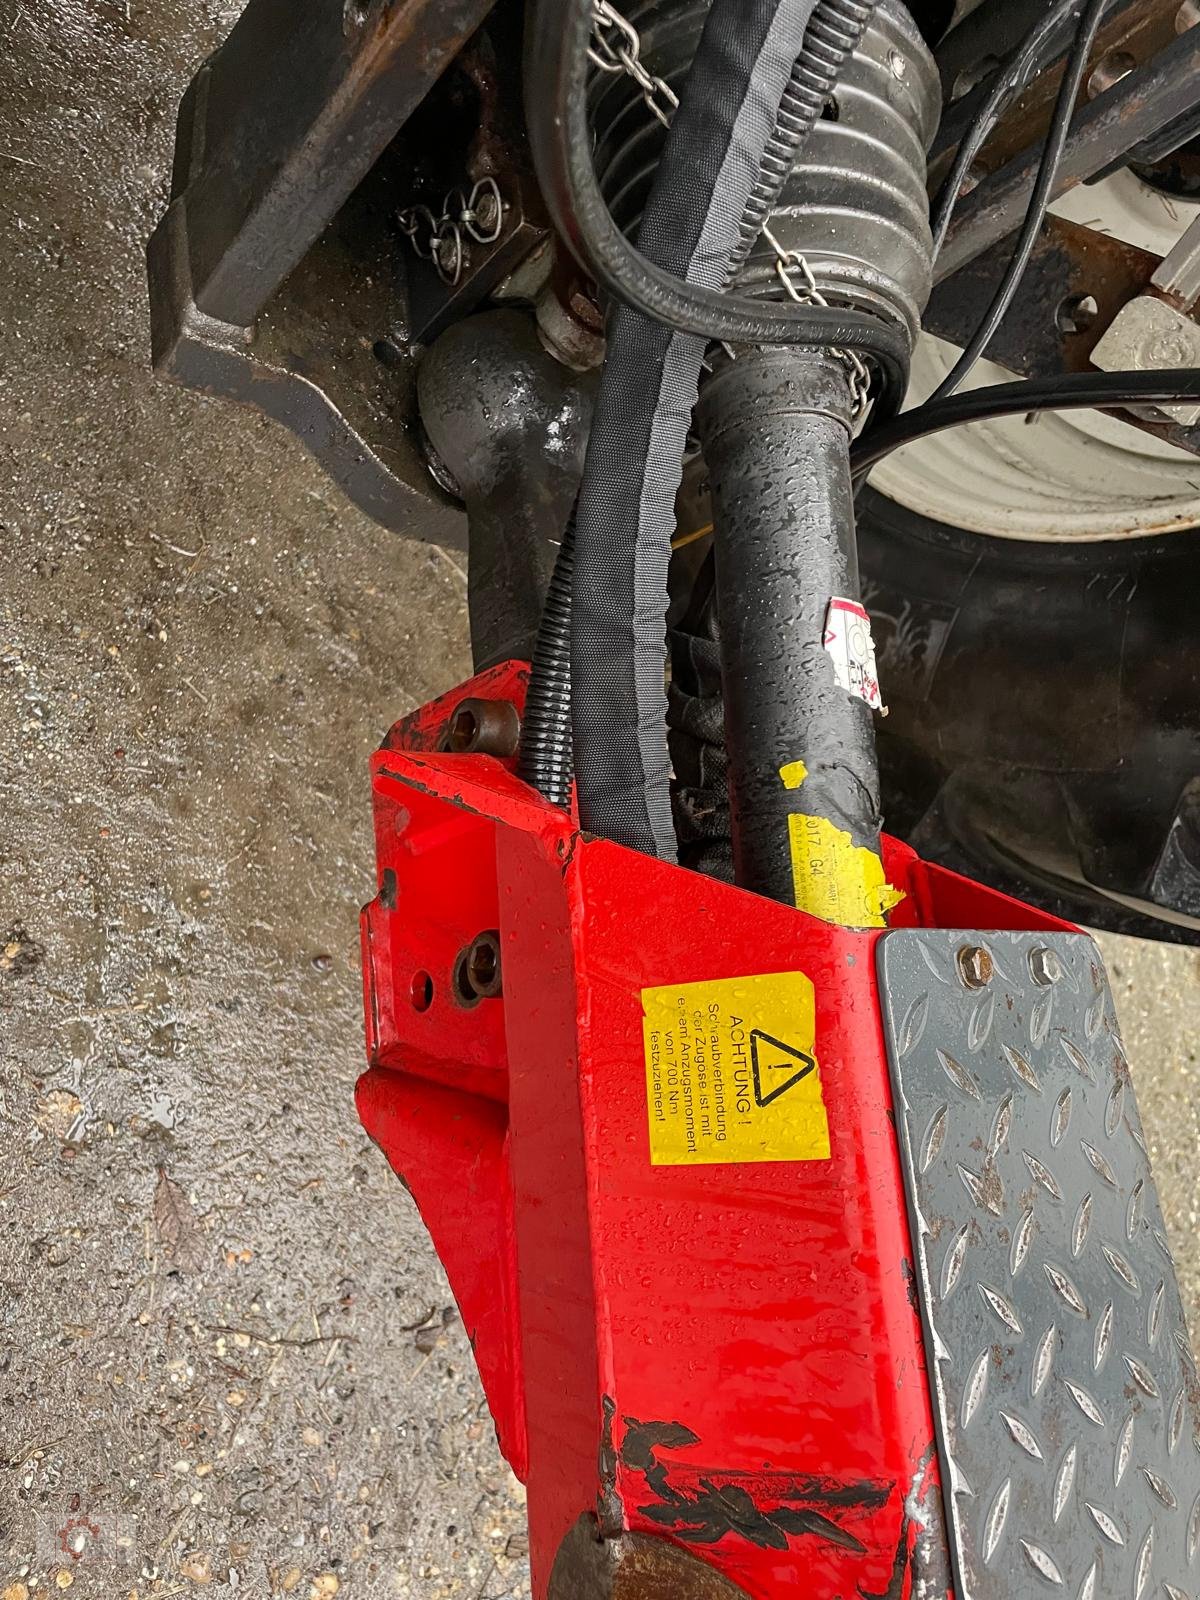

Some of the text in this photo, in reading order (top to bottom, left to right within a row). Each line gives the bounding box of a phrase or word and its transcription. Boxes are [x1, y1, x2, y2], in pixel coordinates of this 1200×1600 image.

[665, 1030, 680, 1115] von 700 Nm
[681, 1043, 697, 1153] Anzugsmoment
[694, 1037, 706, 1090] Zugöse
[730, 1015, 750, 1113] ACHTUNG
[699, 1092, 709, 1110] ist
[701, 1115, 712, 1137] mit
